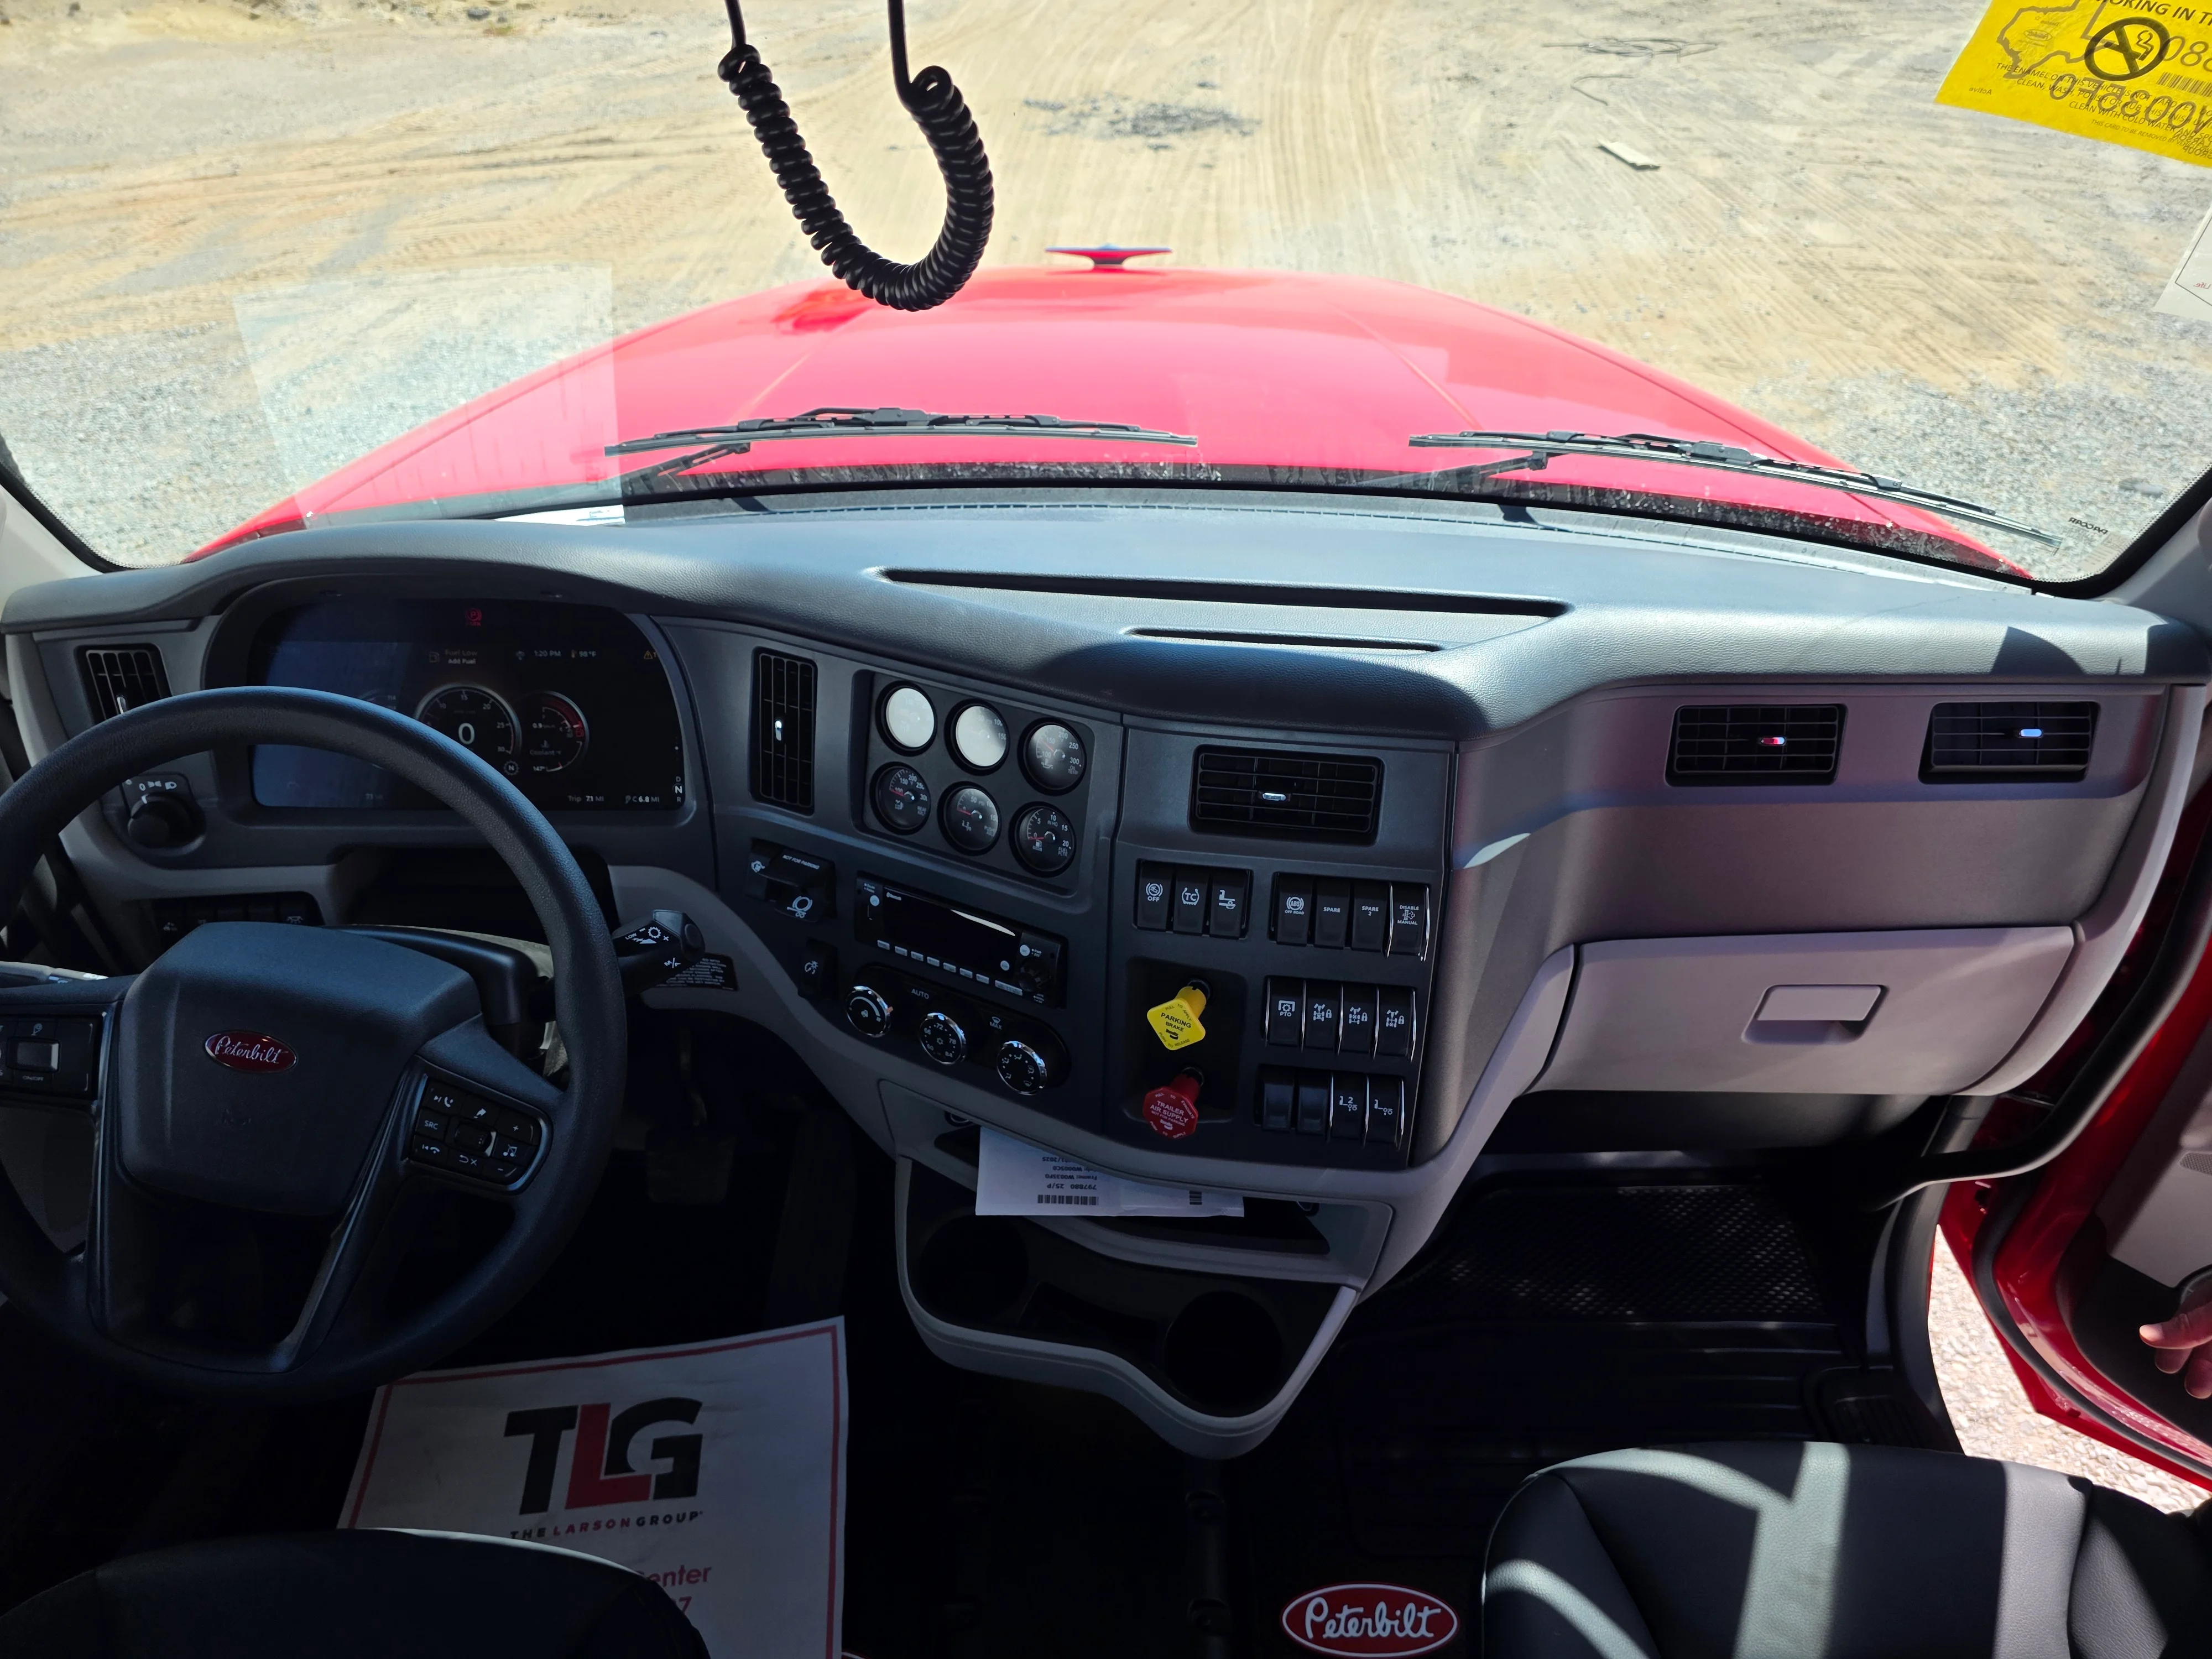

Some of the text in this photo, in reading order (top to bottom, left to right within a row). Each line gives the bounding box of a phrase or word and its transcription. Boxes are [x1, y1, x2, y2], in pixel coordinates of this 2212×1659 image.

[2172, 7, 2196, 20] IN
[1996, 63, 2012, 71] THE
[2013, 66, 2048, 79] ENAMEL
[2068, 76, 2084, 86] THIS
[2088, 81, 2122, 94] VEHICLE
[2017, 79, 2046, 90] CLEAN,
[2109, 98, 2122, 106] OR
[2069, 101, 2097, 113] CLEAN
[2098, 108, 2121, 119] WITH
[2122, 114, 2146, 124] COLD
[2147, 119, 2176, 133] WATER
[2104, 122, 2120, 131] CARD
[2138, 130, 2167, 142] REMOVED
[458, 722, 475, 745] 0
[1058, 731, 1068, 739] 200
[1068, 742, 1079, 750] 250
[1070, 757, 1079, 765] 300
[675, 785, 682, 794] N
[1185, 892, 1197, 901] TC
[911, 988, 930, 1000] AUTO
[1161, 1013, 1191, 1028] PARKING
[1165, 1021, 1184, 1032] BRAKE
[215, 1036, 289, 1065] Peterbilt
[1150, 1104, 1188, 1123] AIR SUPPLY
[1157, 1100, 1185, 1116] TRAILER
[424, 1120, 439, 1130] SRC
[504, 1396, 703, 1515] TLG
[510, 1527, 546, 1539] THE
[553, 1517, 631, 1536] LARSON
[636, 1564, 712, 1587] enter
[1305, 1597, 1441, 1639] Peterbilt
